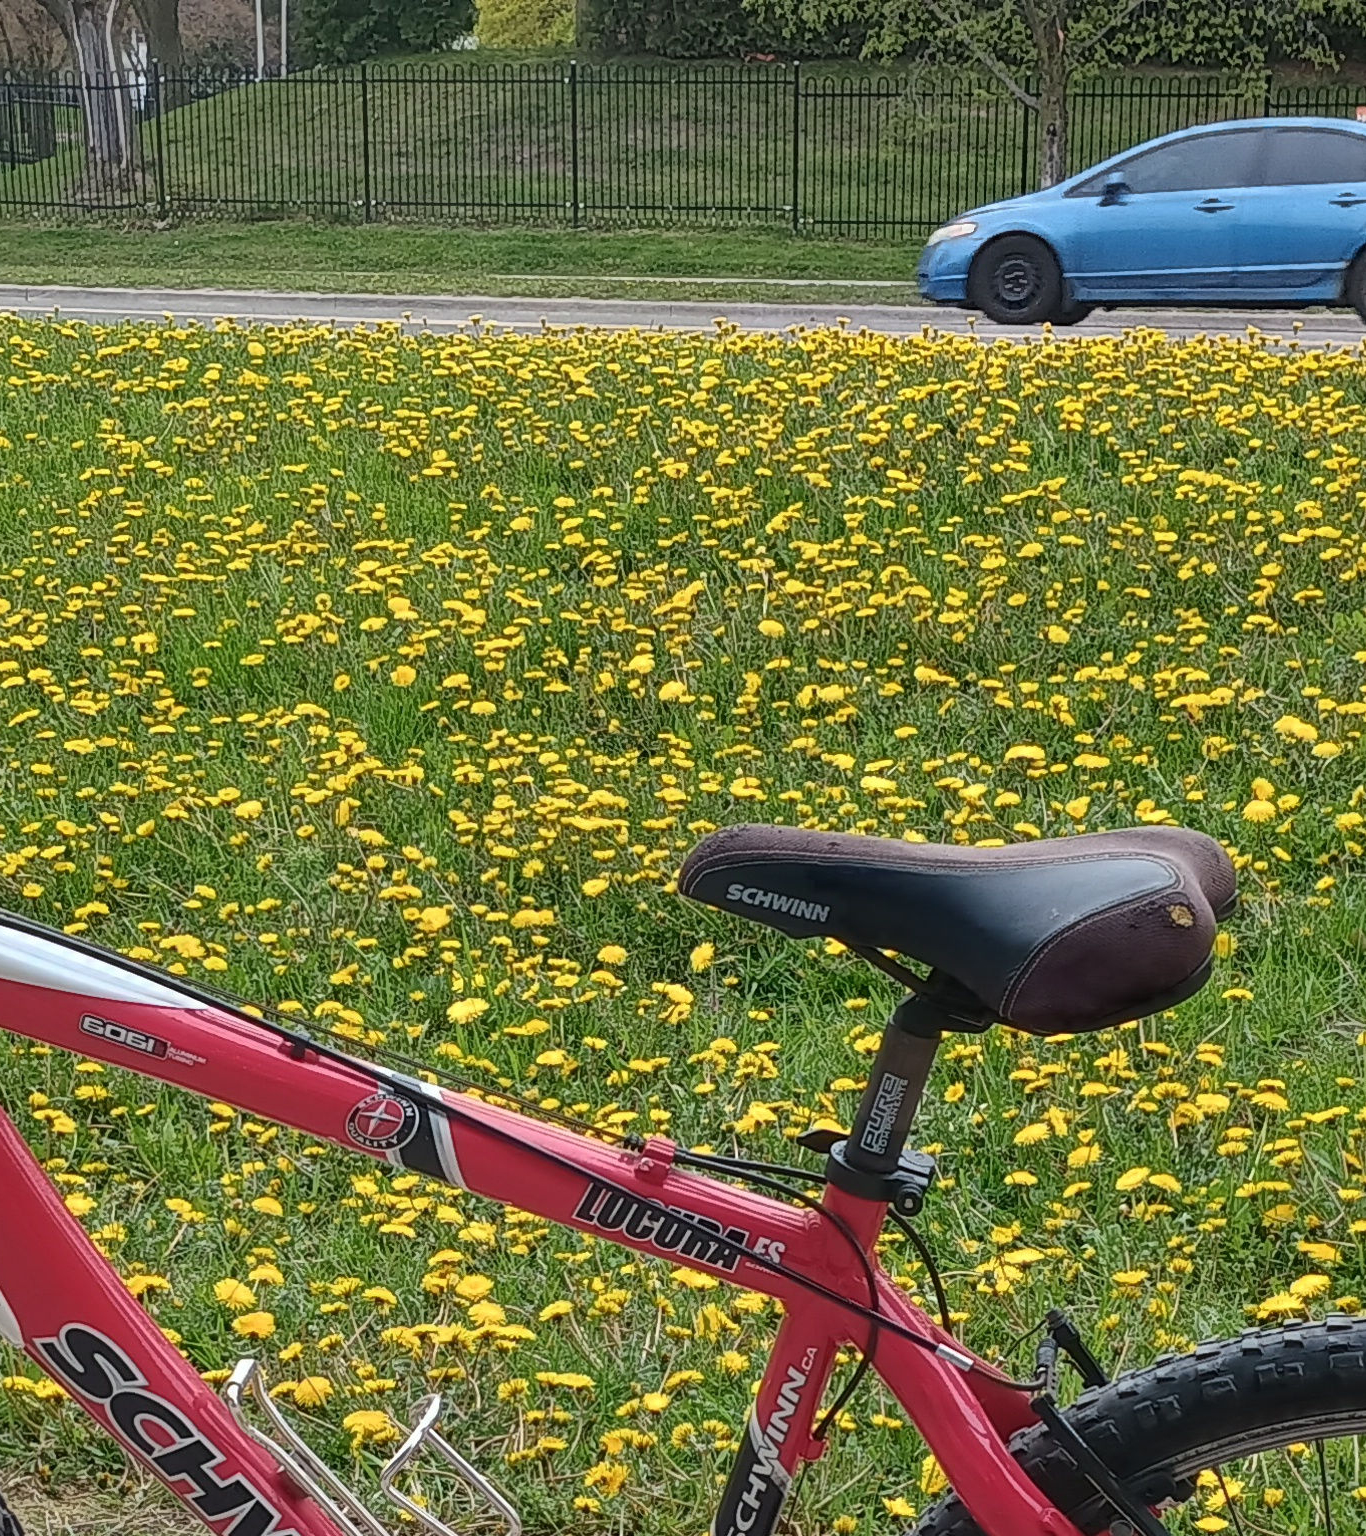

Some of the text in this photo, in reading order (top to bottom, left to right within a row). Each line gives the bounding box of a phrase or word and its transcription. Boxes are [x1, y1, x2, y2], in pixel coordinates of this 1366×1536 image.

[726, 883, 831, 923] SCHWINN
[348, 1122, 399, 1148] QUALITY
[861, 1073, 898, 1151] PURE
[876, 1079, 909, 1154] COMPONENTS
